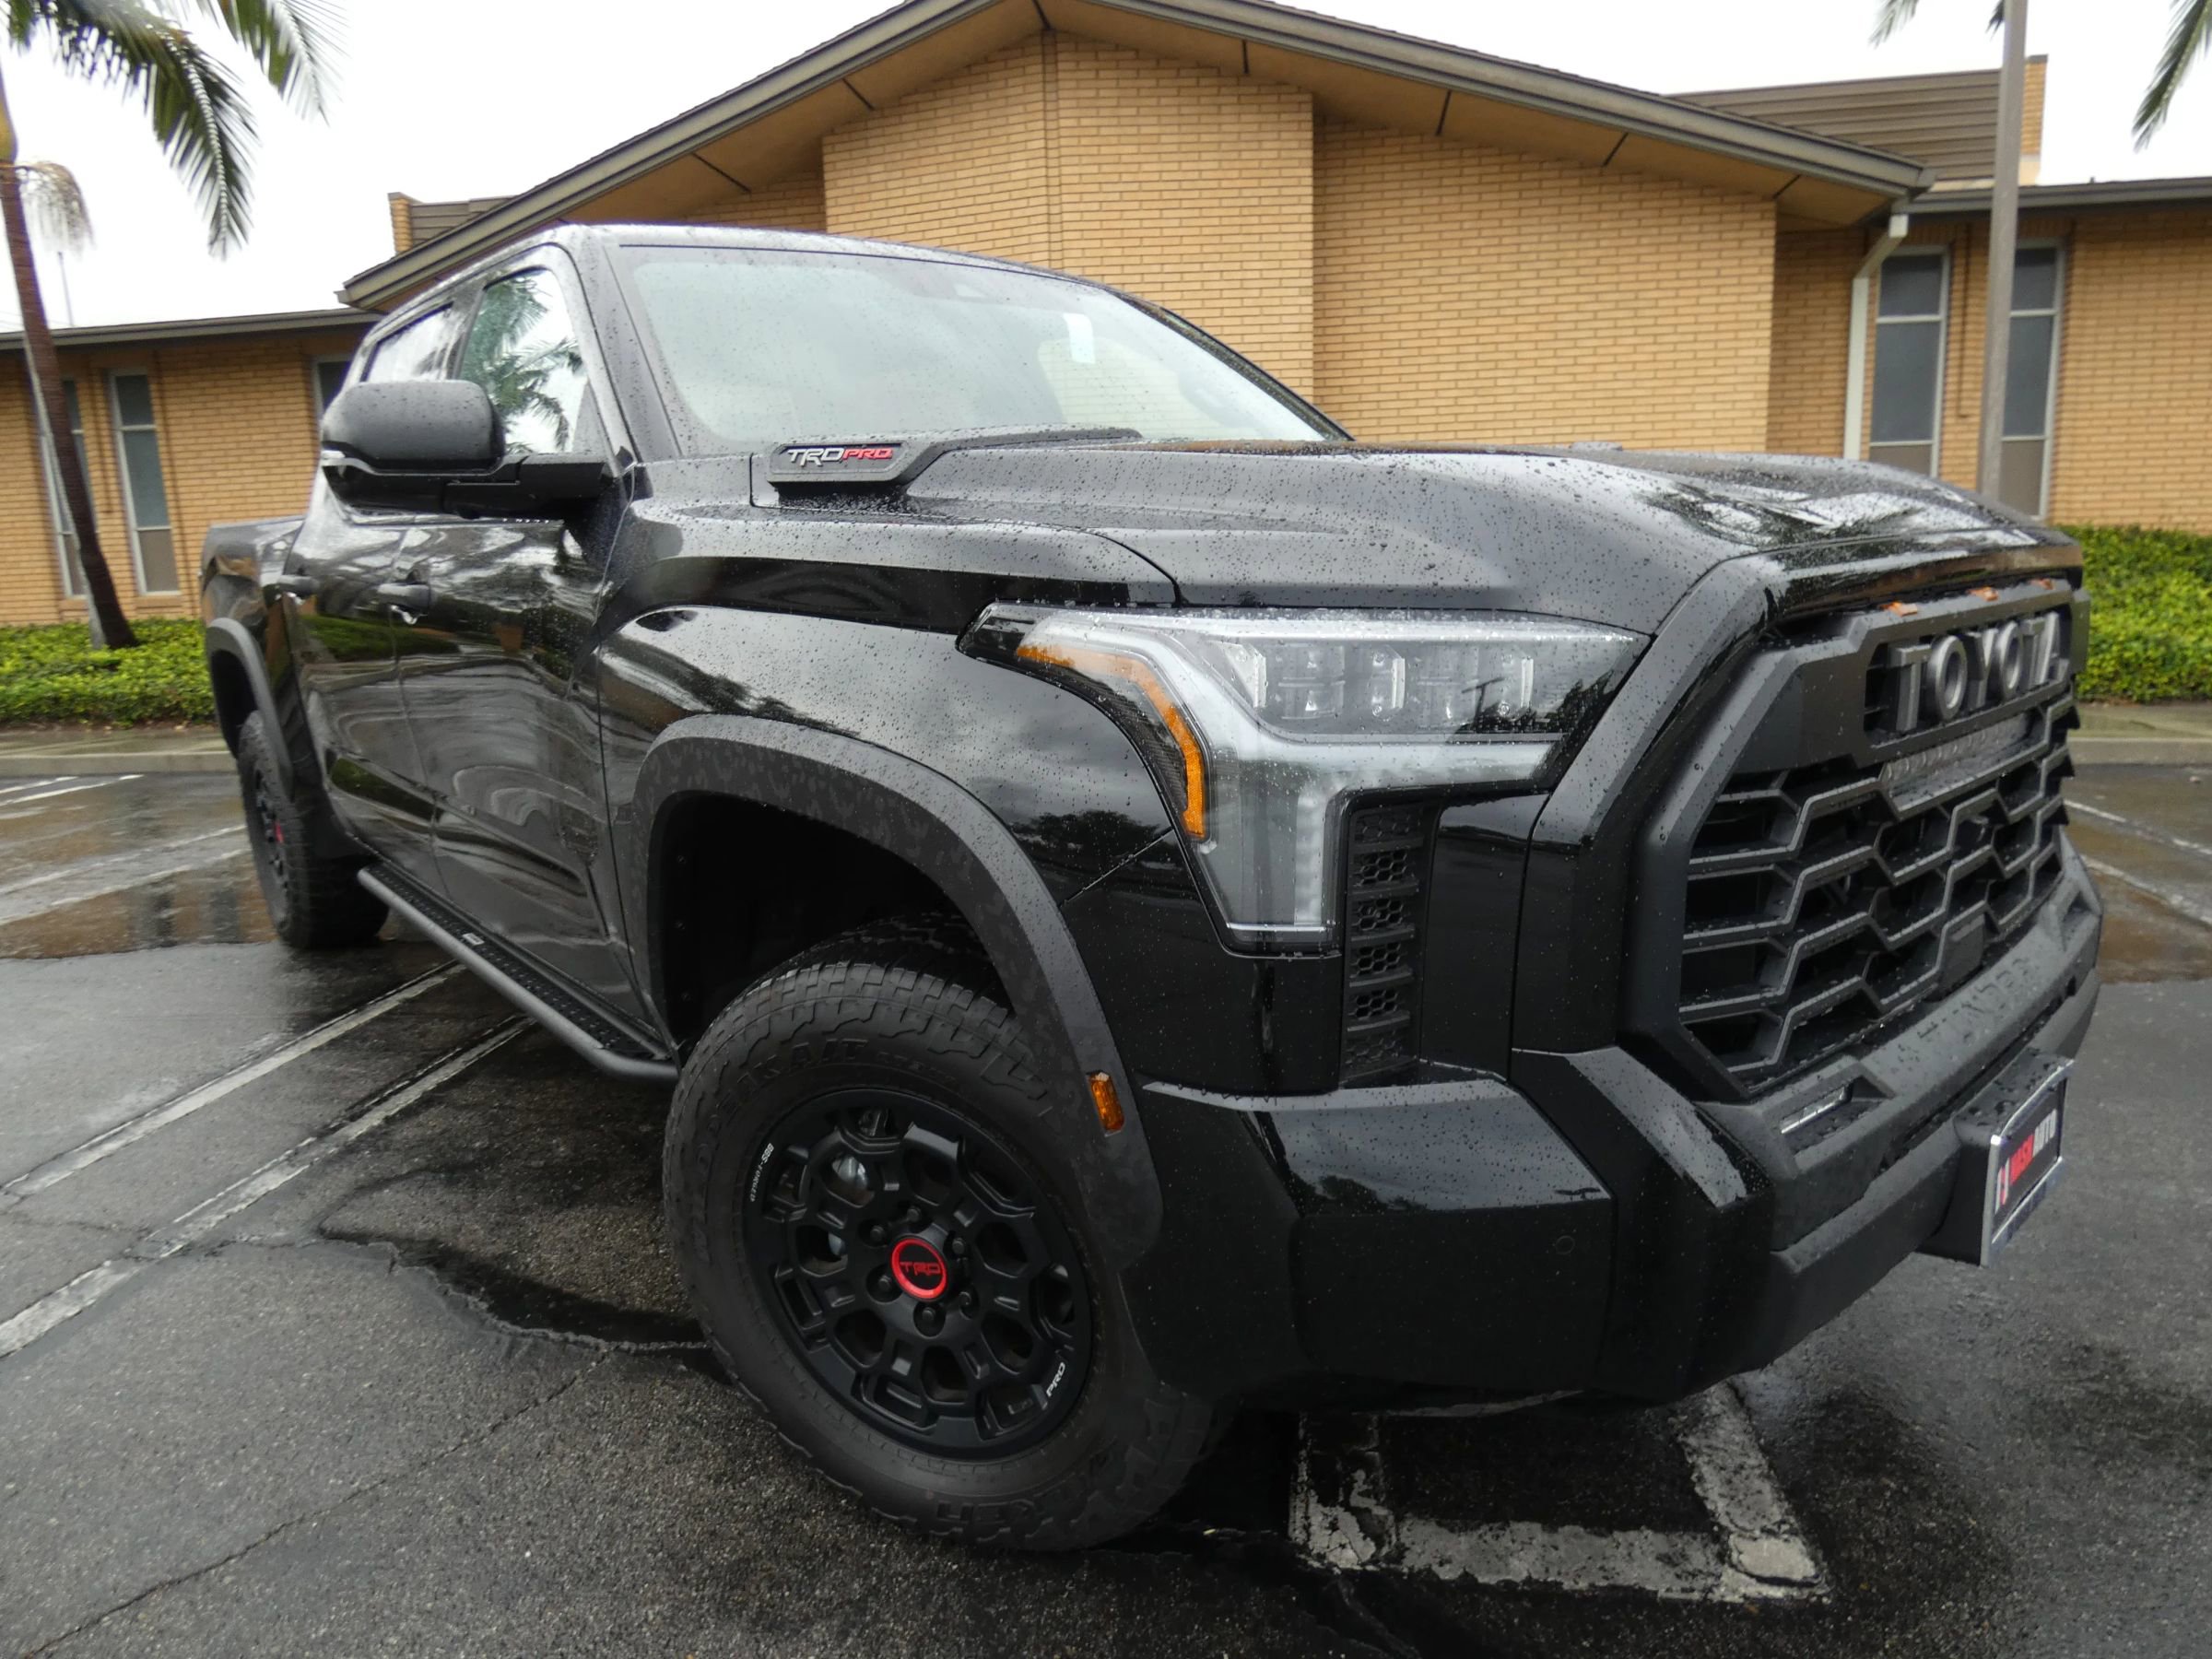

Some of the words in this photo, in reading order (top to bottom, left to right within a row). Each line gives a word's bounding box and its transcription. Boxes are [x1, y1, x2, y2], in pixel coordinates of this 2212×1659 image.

[1894, 612, 2071, 732] TOYOTA
[899, 1261, 941, 1276] TRD
[1046, 1361, 1065, 1397] PRO
